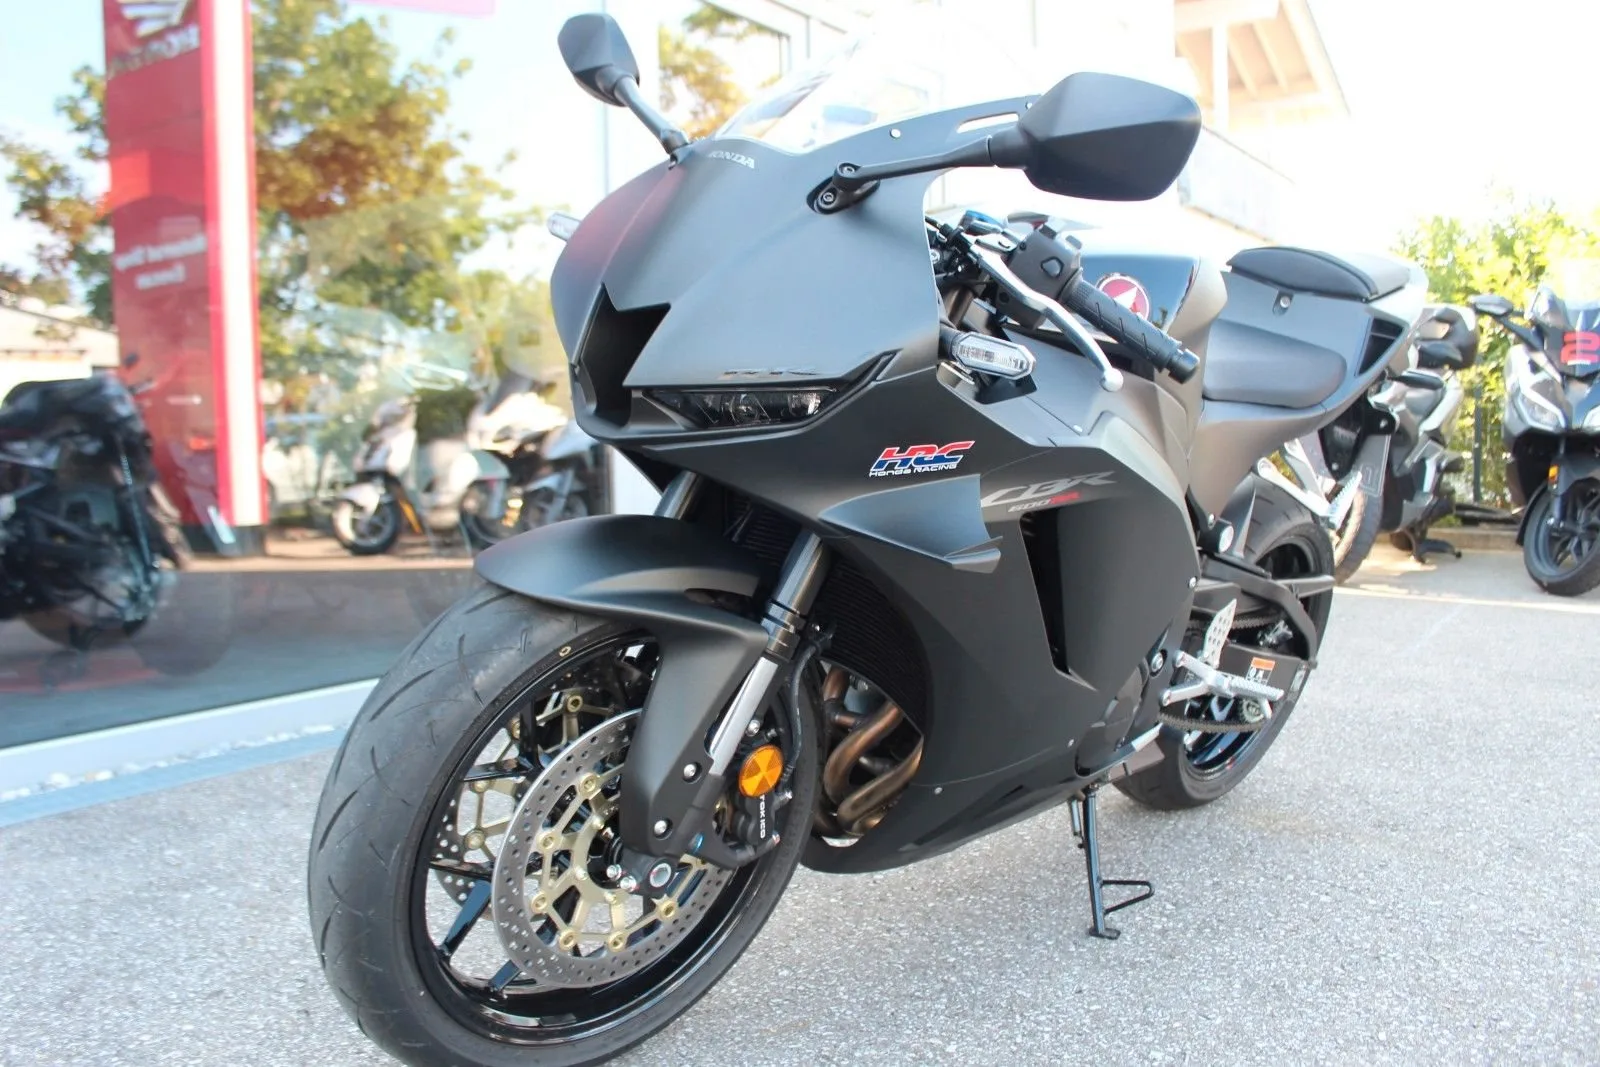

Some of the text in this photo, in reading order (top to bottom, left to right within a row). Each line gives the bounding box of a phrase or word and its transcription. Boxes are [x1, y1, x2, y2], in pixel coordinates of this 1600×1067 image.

[870, 440, 975, 472] HRC
[913, 463, 957, 473] RACING
[981, 471, 1117, 508] CBR
